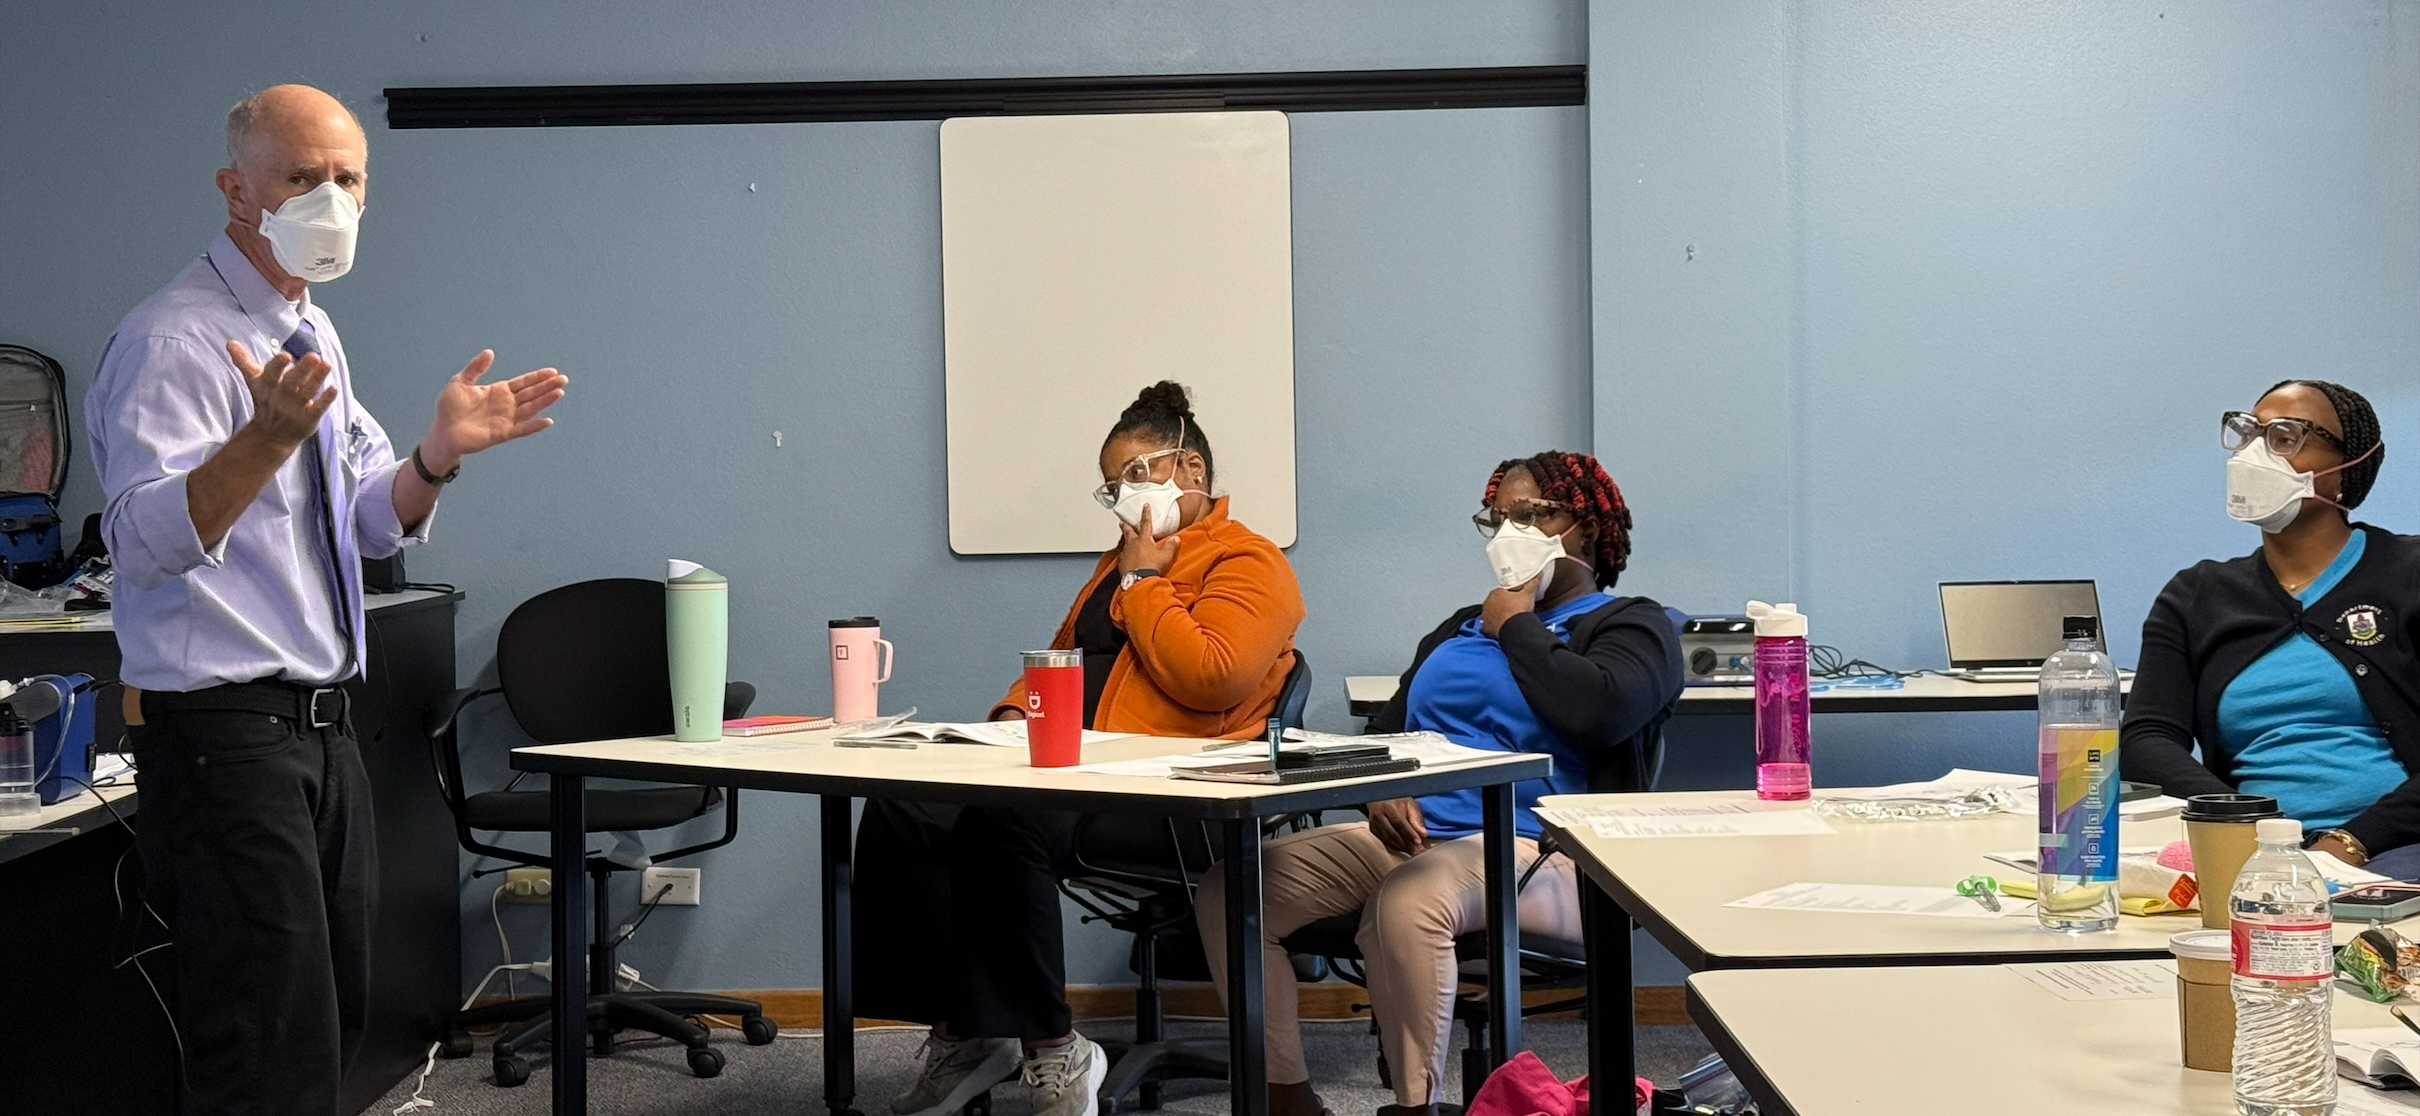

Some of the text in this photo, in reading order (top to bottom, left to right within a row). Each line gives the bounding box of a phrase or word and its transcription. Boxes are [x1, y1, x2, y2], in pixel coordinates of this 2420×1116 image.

[314, 257, 336, 266] 3M
[2231, 494, 2246, 504] 3M
[2356, 633, 2386, 647] Health
